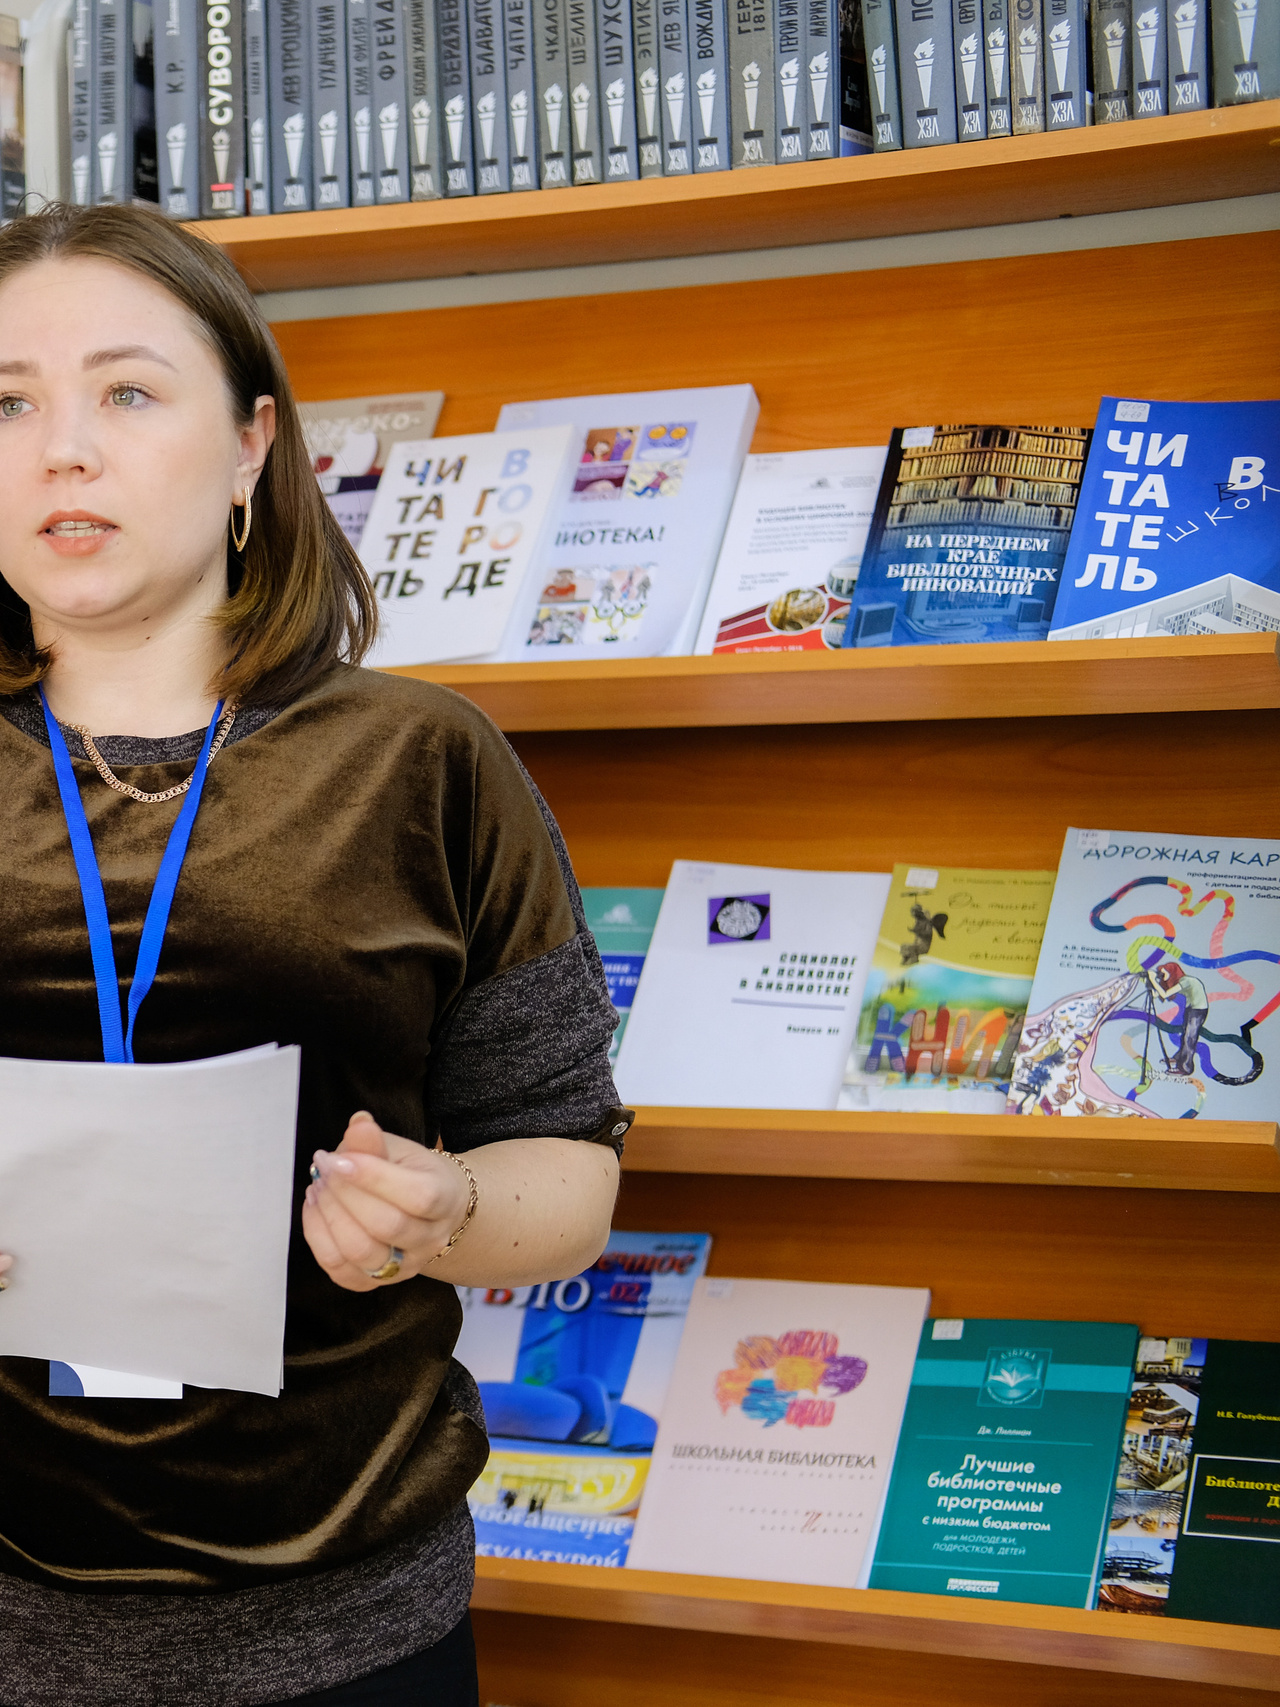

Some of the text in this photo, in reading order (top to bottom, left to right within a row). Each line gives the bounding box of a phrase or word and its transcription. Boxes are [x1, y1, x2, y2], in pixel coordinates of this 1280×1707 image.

[571, 0, 587, 66] ШЕЛЛИ
[665, 22, 683, 53] ЛЕВ
[779, 0, 800, 55] ГЕРОИ БИ
[318, 5, 338, 90] ТУХАЧЕВСКИЙ
[375, 0, 396, 82] ФРЕЙД
[411, 0, 427, 98] БОГДАН ХМЕЛЬНИ
[98, 13, 117, 126] ВАЛЕНТИН РАСПУТИН
[207, 0, 234, 126] СУВОРО
[351, 17, 369, 97] КИМ ФИЛБИ
[166, 59, 185, 95] К.Р.
[1234, 71, 1261, 96] ЖЗЛ
[282, 74, 302, 106] ЛЕВ
[1137, 89, 1162, 113] ЖЗЛ
[1175, 81, 1201, 106] ЖЗЛ
[73, 79, 89, 143] ФРЕЙД
[962, 112, 982, 135] ЖЗЛ
[990, 109, 1009, 130] ЖЗЛ
[1051, 101, 1075, 124] ЖЗЛ
[1104, 101, 1128, 121] ЖЗЛ
[809, 130, 831, 152] ЖЗЛ
[916, 117, 940, 140] ЖЗЛ
[780, 136, 802, 158] ЖЗЛ
[1105, 429, 1189, 468] ЧИ
[403, 448, 531, 487] ЧИ В
[1227, 456, 1266, 491] В
[1101, 471, 1170, 508] ТА
[396, 493, 444, 525] ТА
[472, 484, 533, 517] ГО
[384, 520, 524, 562] ТЕ РО
[904, 533, 1050, 552] НА ПЕРЕДНЕМ
[1095, 511, 1165, 550] ТЕ
[946, 549, 1001, 565] КРАЕ
[441, 558, 513, 601] ДЕ
[886, 563, 1058, 582] БИБЛИОТЕЧНЫХ
[1074, 552, 1159, 593] ЛЬ
[901, 577, 1036, 597] ИННОВАЦИЙ
[1083, 844, 1280, 867] ДОРОЖНАЯ КАР
[779, 952, 857, 966] СОЦИОЛОГ
[761, 966, 853, 980] И ПСИХОЛОГ
[739, 979, 850, 996] В БИБЛИОТЕКЕ
[671, 1443, 877, 1469] ШКОЛЬНАЯ БИБЛИОТЕКА
[959, 1454, 1036, 1476] Лучшие
[926, 1470, 1063, 1495] библиотечные
[1204, 1475, 1280, 1492] Библиоте
[936, 1495, 1044, 1514] программы
[922, 1515, 1052, 1531] с низким бюджетом
